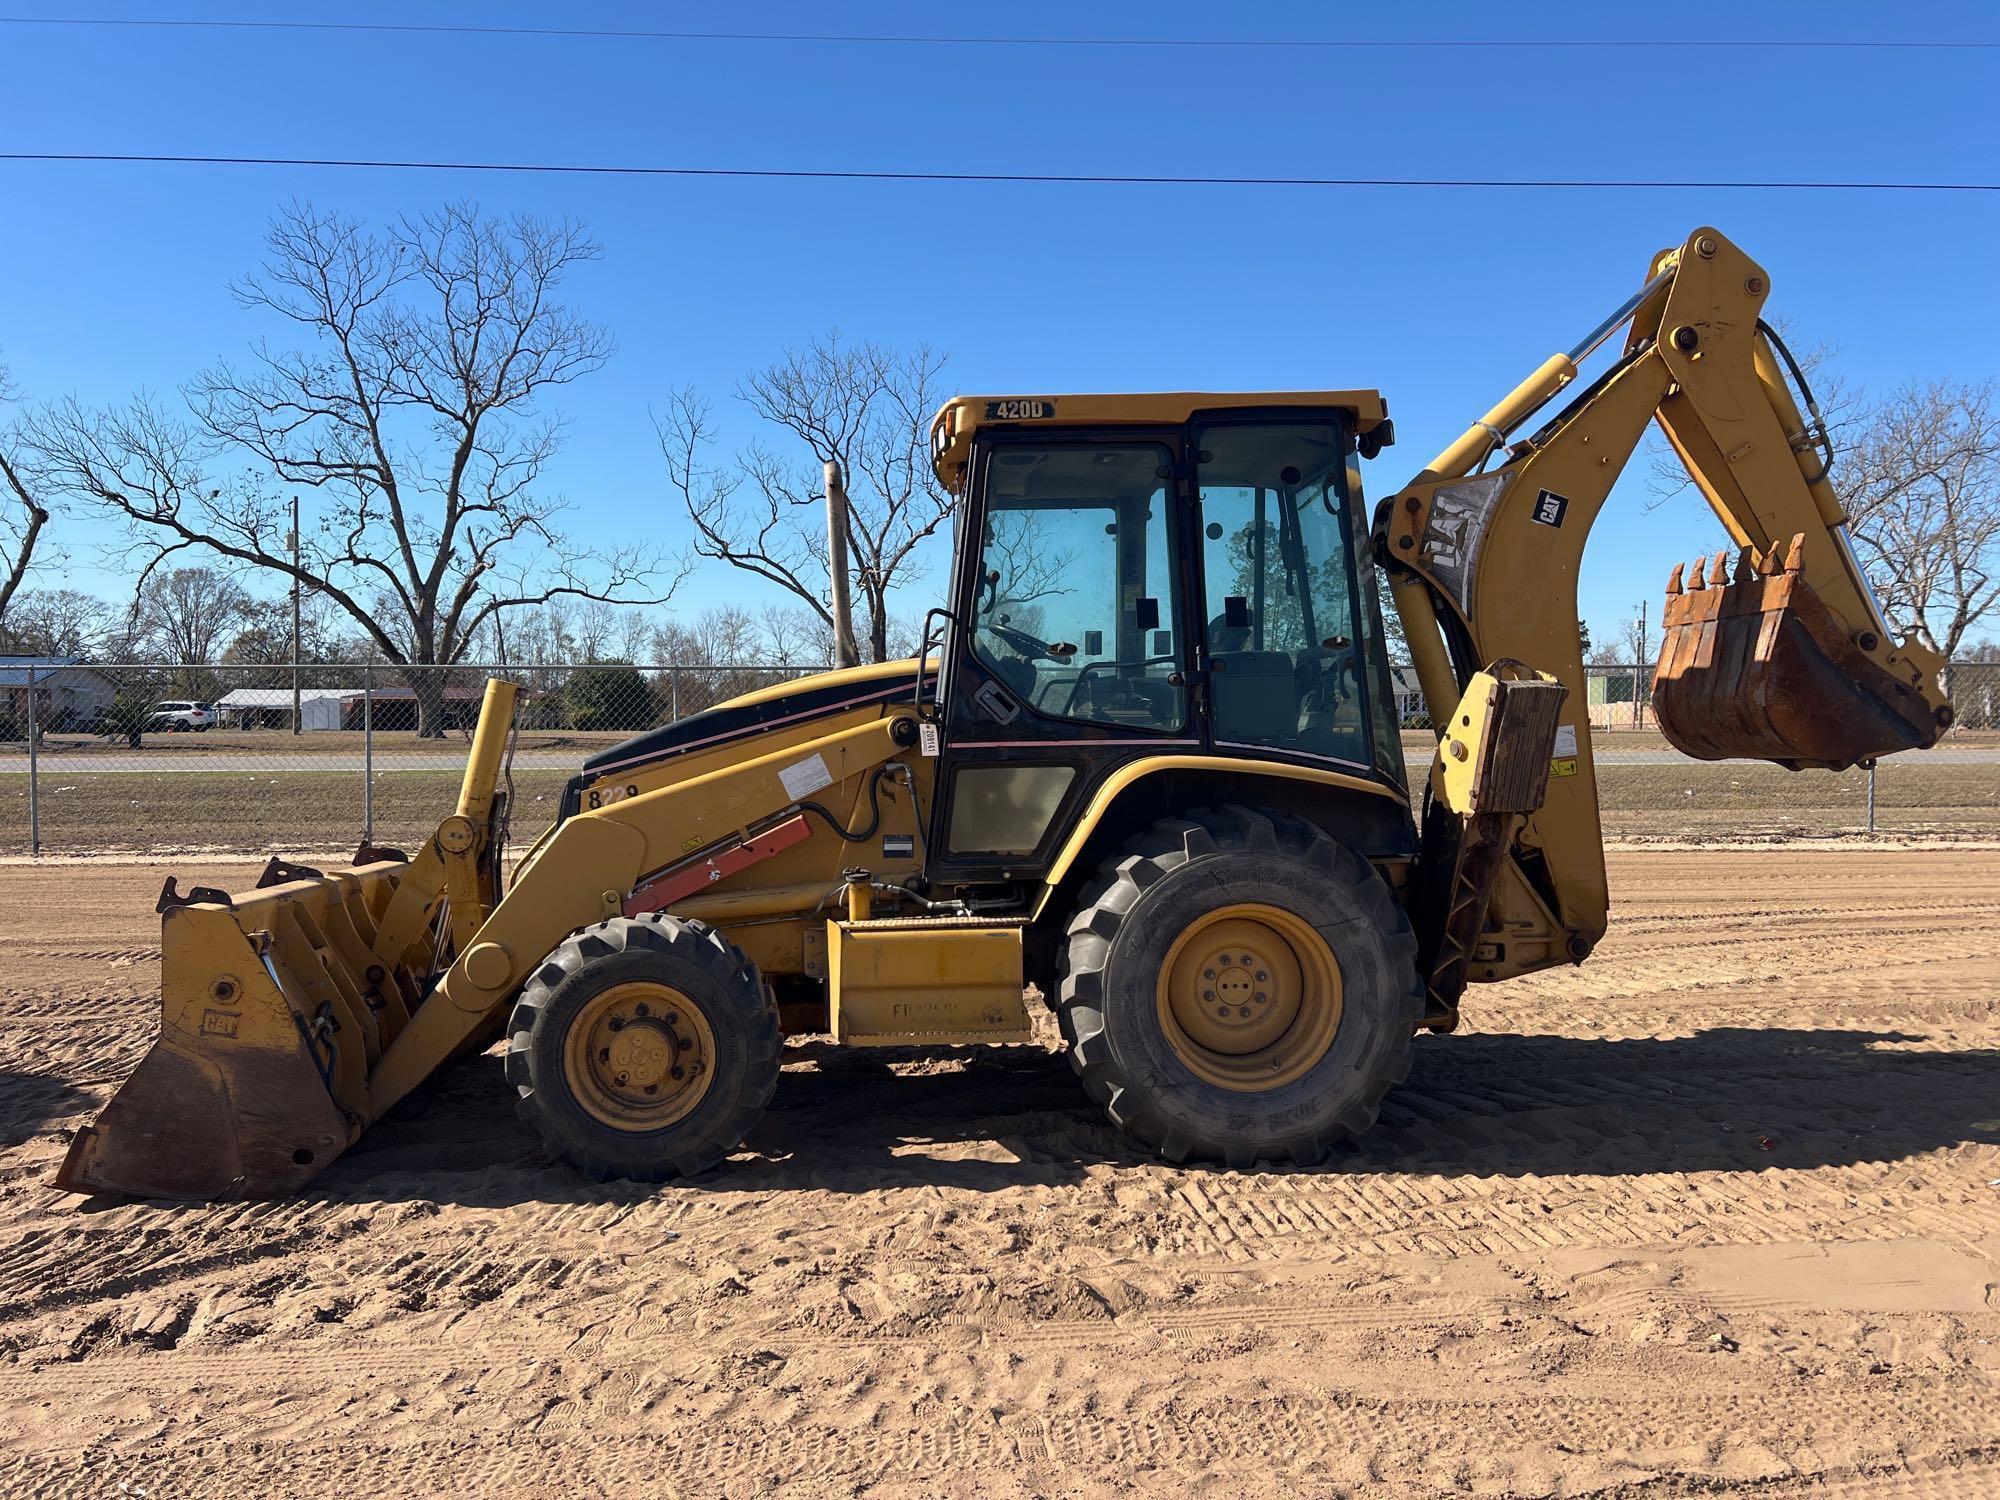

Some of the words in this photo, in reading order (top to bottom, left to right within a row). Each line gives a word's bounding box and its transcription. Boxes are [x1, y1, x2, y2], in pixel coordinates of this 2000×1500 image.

[997, 401, 1043, 419] 420D
[1540, 494, 1560, 523] CAT
[926, 730, 936, 752] 209141
